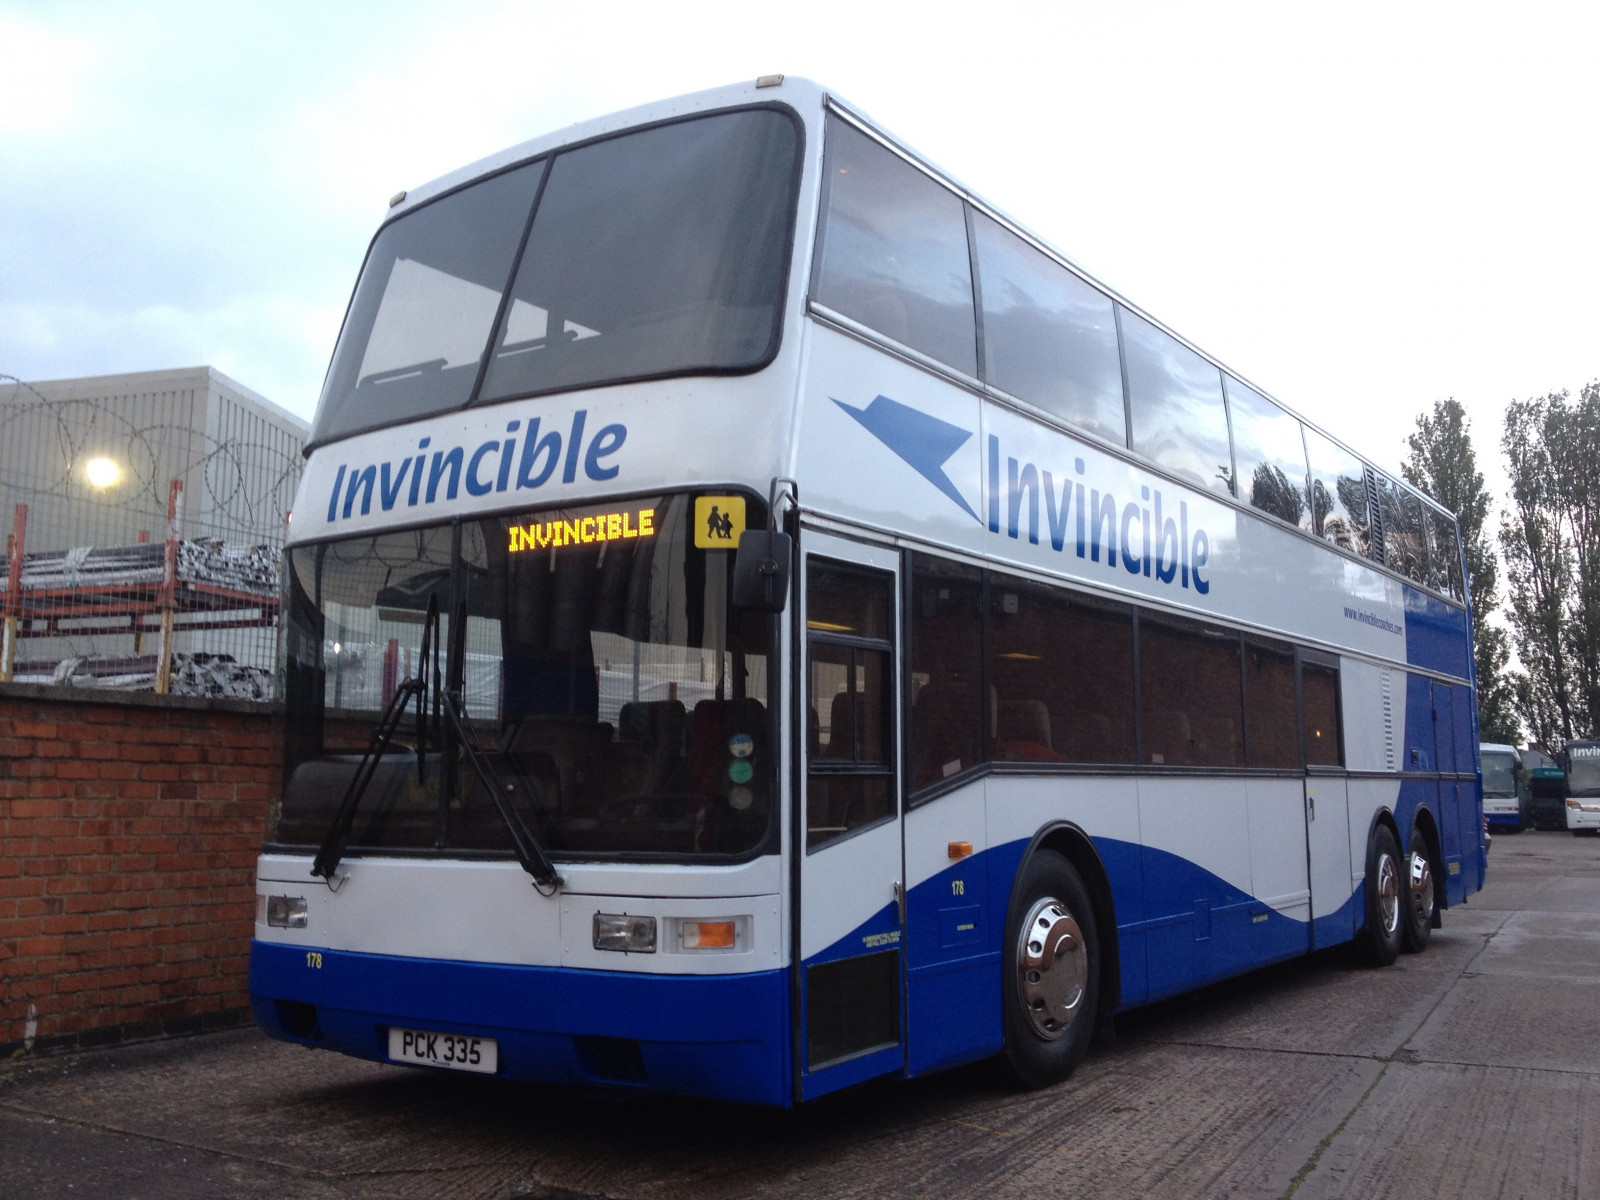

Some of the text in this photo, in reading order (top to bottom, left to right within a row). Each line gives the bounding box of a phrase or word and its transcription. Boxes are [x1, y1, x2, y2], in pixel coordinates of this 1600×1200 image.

[326, 410, 627, 522] Invincible
[508, 508, 655, 553] INVINCIBLE
[987, 433, 1210, 595] Invincible
[952, 880, 964, 895] 178
[306, 952, 322, 969] 178
[403, 1031, 481, 1065] PCK 335
